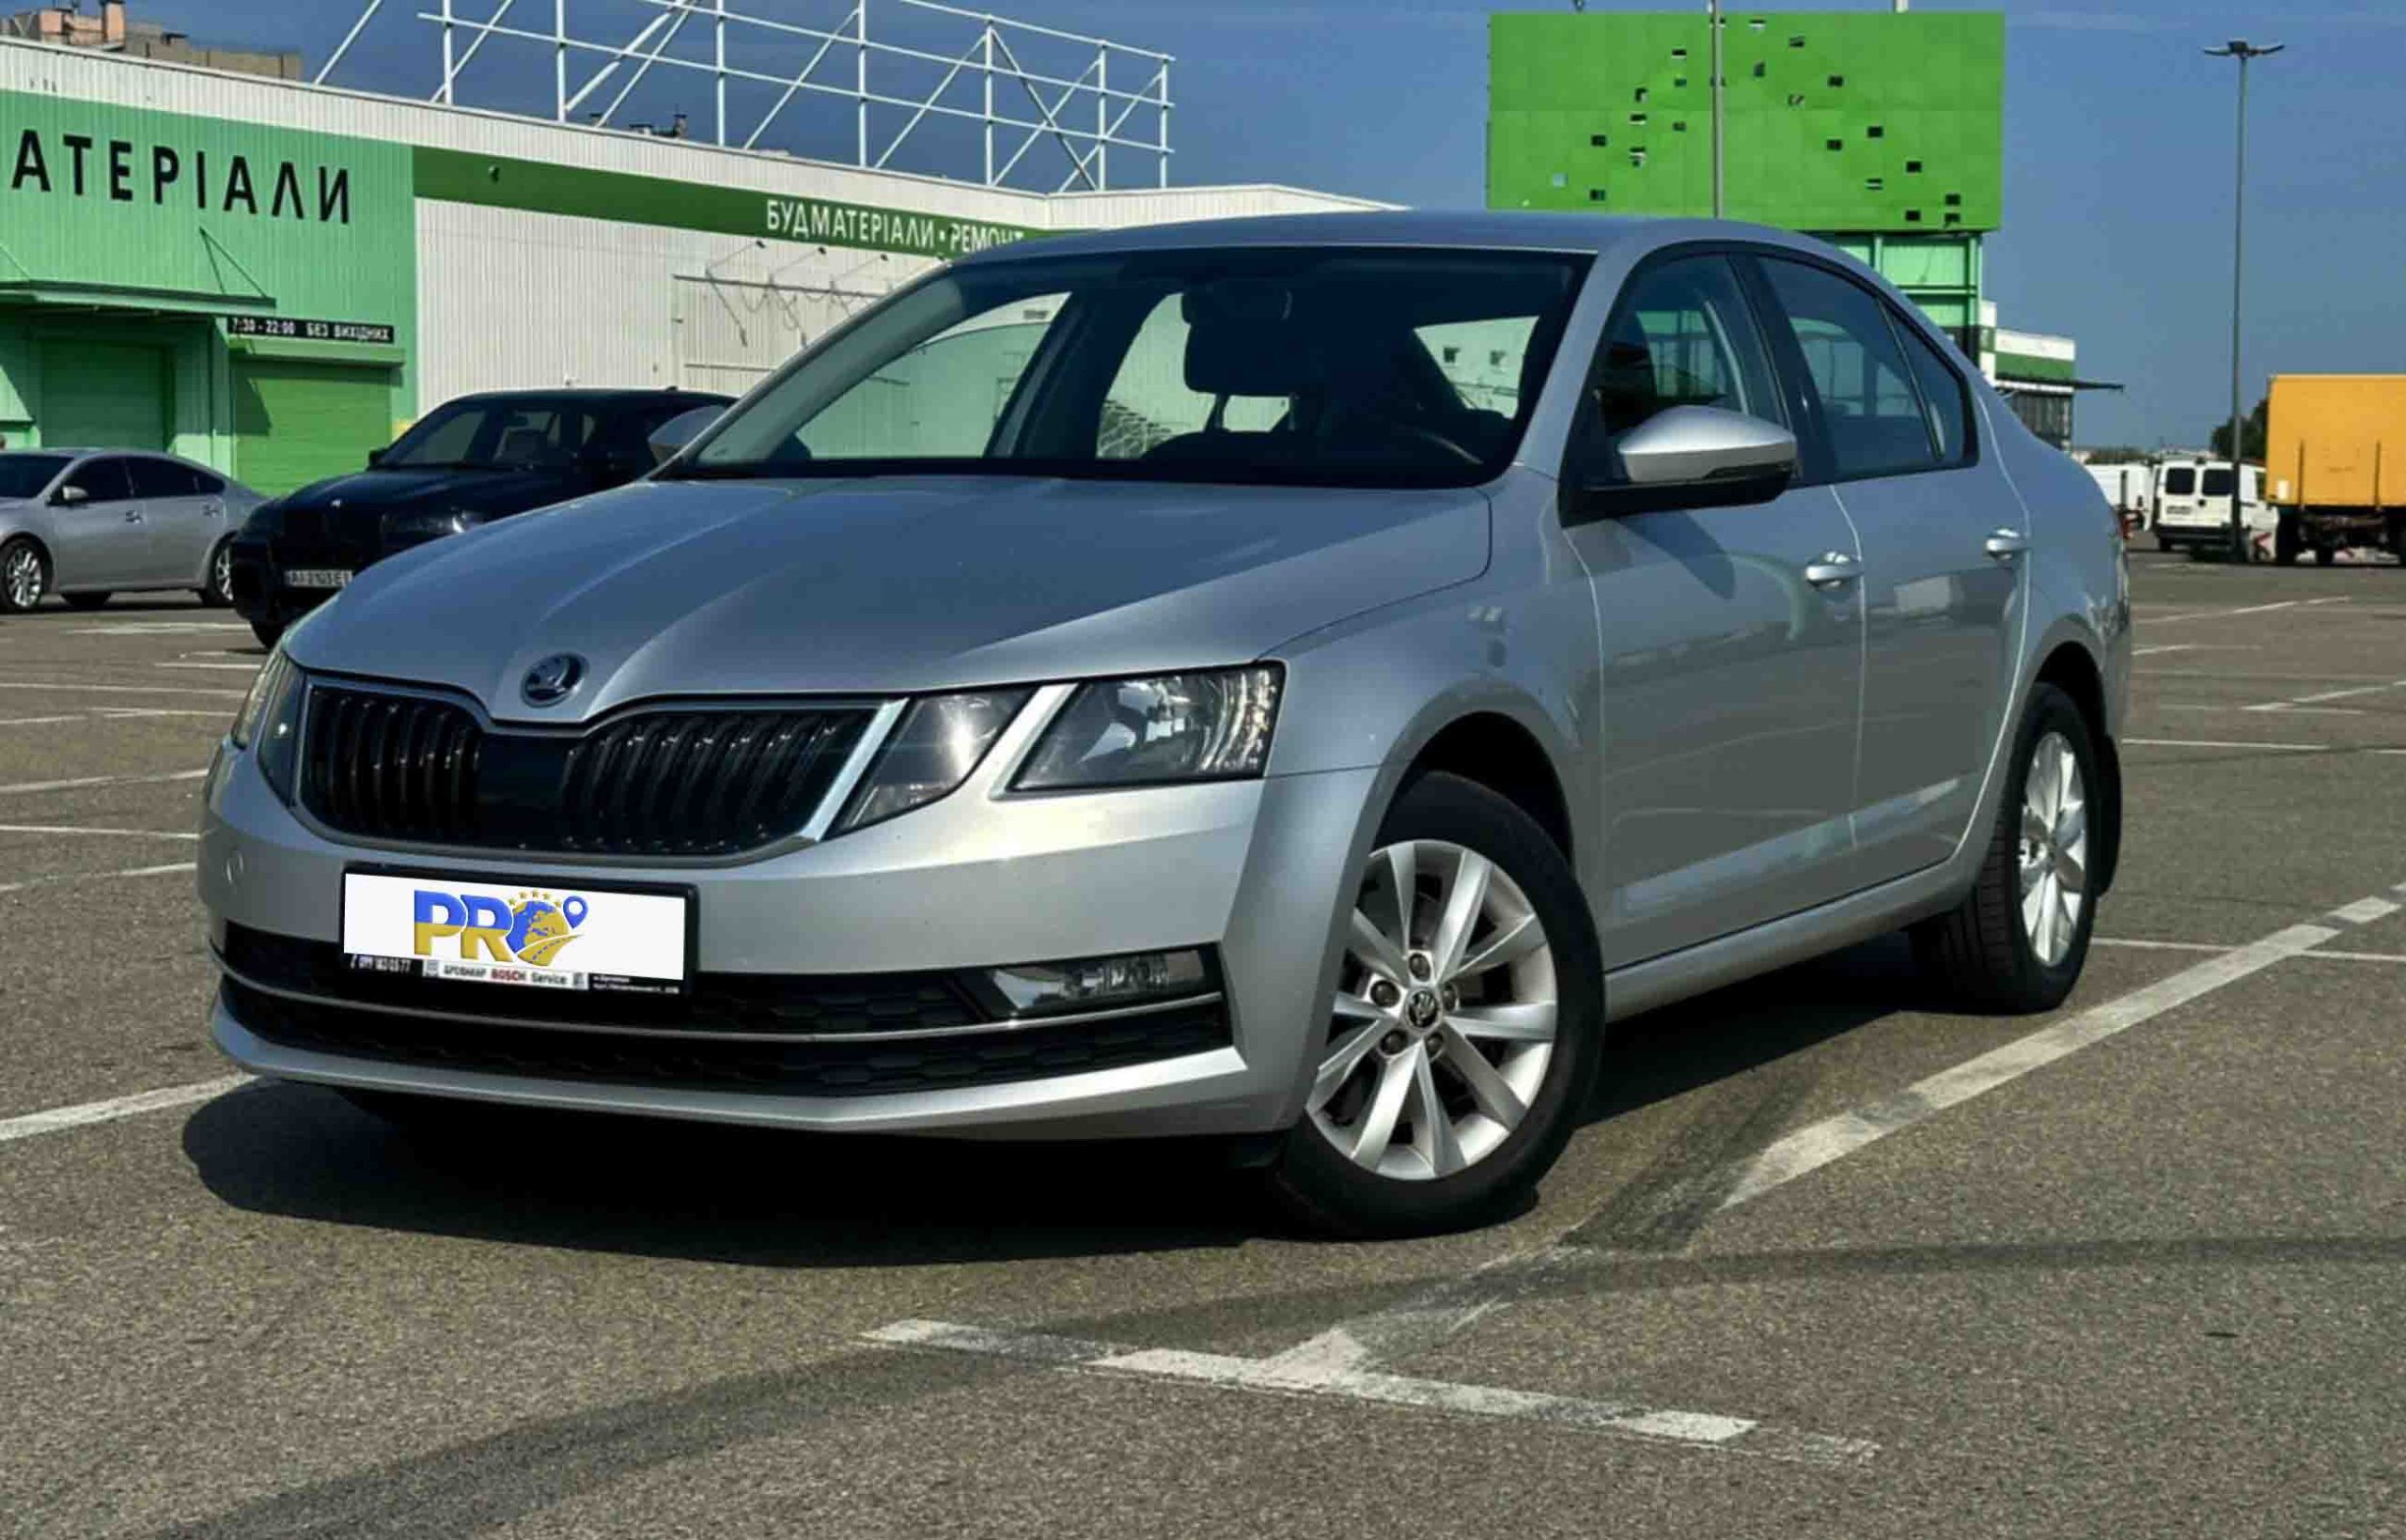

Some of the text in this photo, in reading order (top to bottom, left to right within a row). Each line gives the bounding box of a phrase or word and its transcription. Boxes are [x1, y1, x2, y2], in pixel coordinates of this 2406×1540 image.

[11, 129, 349, 224] АТЕРІАЛИ
[767, 199, 934, 249] БУДМАТЕРІАЛИ
[266, 319, 296, 334] 22:00
[306, 322, 329, 337] БЕЗ
[491, 968, 527, 983] BOSCH
[530, 971, 568, 987] Service
